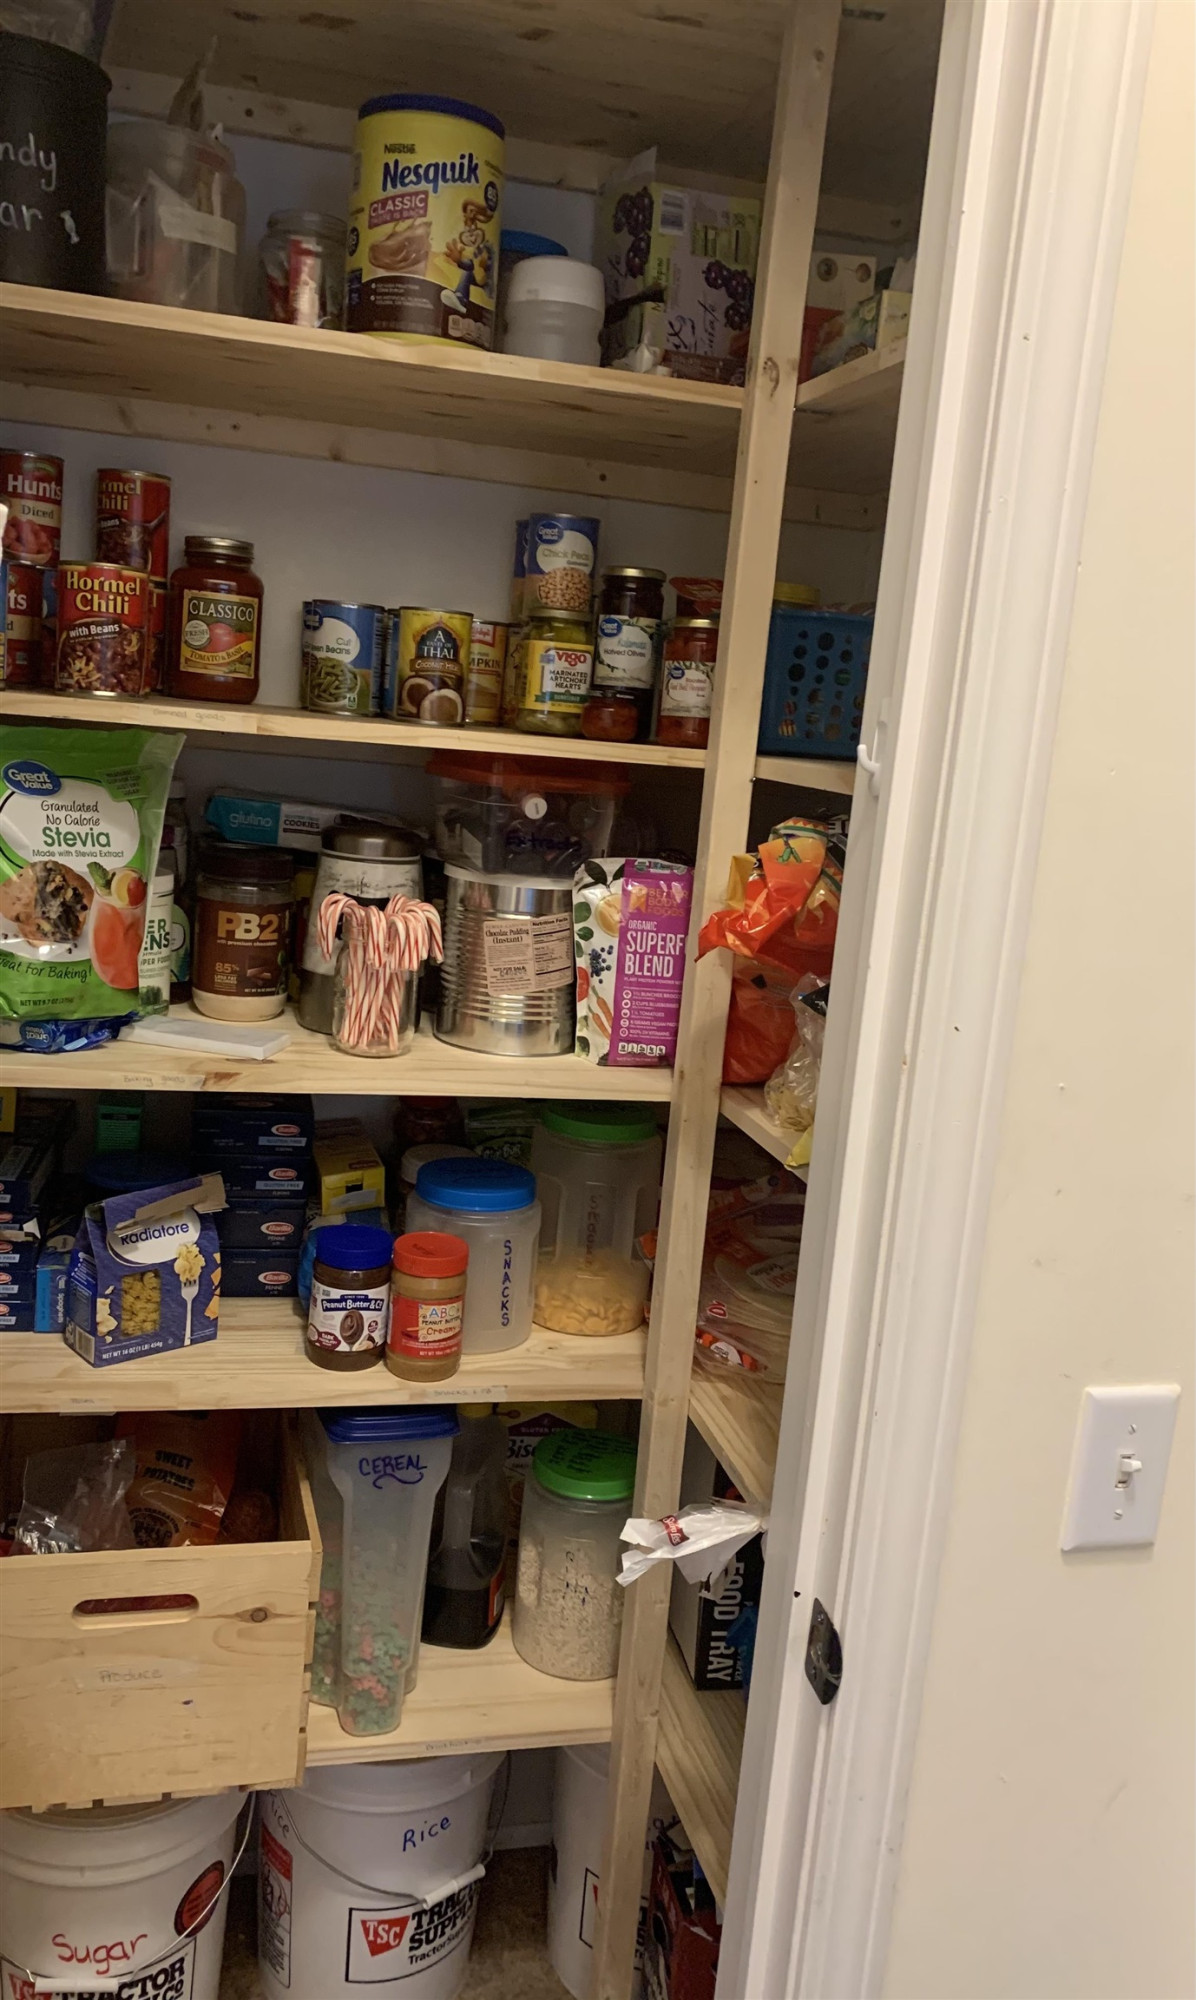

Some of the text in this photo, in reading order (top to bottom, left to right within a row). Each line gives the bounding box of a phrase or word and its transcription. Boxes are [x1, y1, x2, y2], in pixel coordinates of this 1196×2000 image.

[382, 153, 479, 194] Nesquik
[370, 194, 426, 217] CLASSIC
[21, 504, 55, 520] Diced
[537, 526, 559, 535] Great
[542, 548, 568, 560] Chick
[67, 571, 141, 596] Hormel
[76, 592, 129, 615] Chili
[189, 600, 254, 622] CLASSICO
[69, 622, 120, 638] with Beans
[336, 637, 352, 648] Cut
[434, 631, 446, 646] A
[190, 649, 220, 663] TOMATO
[226, 645, 245, 660] BASIL
[325, 645, 352, 656] Beans
[422, 646, 456, 661] THAI
[604, 648, 647, 658] Halved Olives
[549, 669, 588, 679] MARINATED
[550, 676, 588, 686] ARTICHOKE
[555, 682, 581, 691] HEARTS
[7, 769, 51, 784] Great
[22, 780, 54, 791] Value
[41, 800, 100, 814] Granulated
[46, 814, 101, 828] No Calorie
[283, 818, 320, 830] COOKIES
[42, 826, 111, 848] Stevia
[32, 849, 125, 858] Made with Stevia Extract
[148, 918, 167, 935] ER
[217, 911, 278, 941] PB2
[532, 919, 555, 927] Nutrition
[627, 919, 658, 932] ORGANIC
[492, 935, 523, 945] (Instant)
[509, 928, 530, 937] Pudding
[626, 935, 684, 961] SUPERF
[25, 958, 45, 977] For
[48, 965, 92, 984] Baking!
[215, 962, 240, 973] 85%
[624, 954, 674, 982] BLEND
[26, 1032, 50, 1042] Great
[121, 1222, 190, 1246] Radiatore
[502, 1239, 514, 1328] SNACKS
[322, 1300, 347, 1310] Peanut
[347, 1299, 370, 1310] Butter
[421, 1318, 443, 1326] PEANUT
[321, 1332, 335, 1340] DARK
[425, 1326, 457, 1337] Creamy
[112, 1350, 121, 1358] WT
[155, 1449, 193, 1470] SWEET
[358, 1454, 427, 1477] CEREAL
[662, 1516, 678, 1534] Sara
[402, 1815, 452, 1853] Rice
[365, 1921, 402, 1947] TSC
[51, 1933, 149, 1976] Sugar
